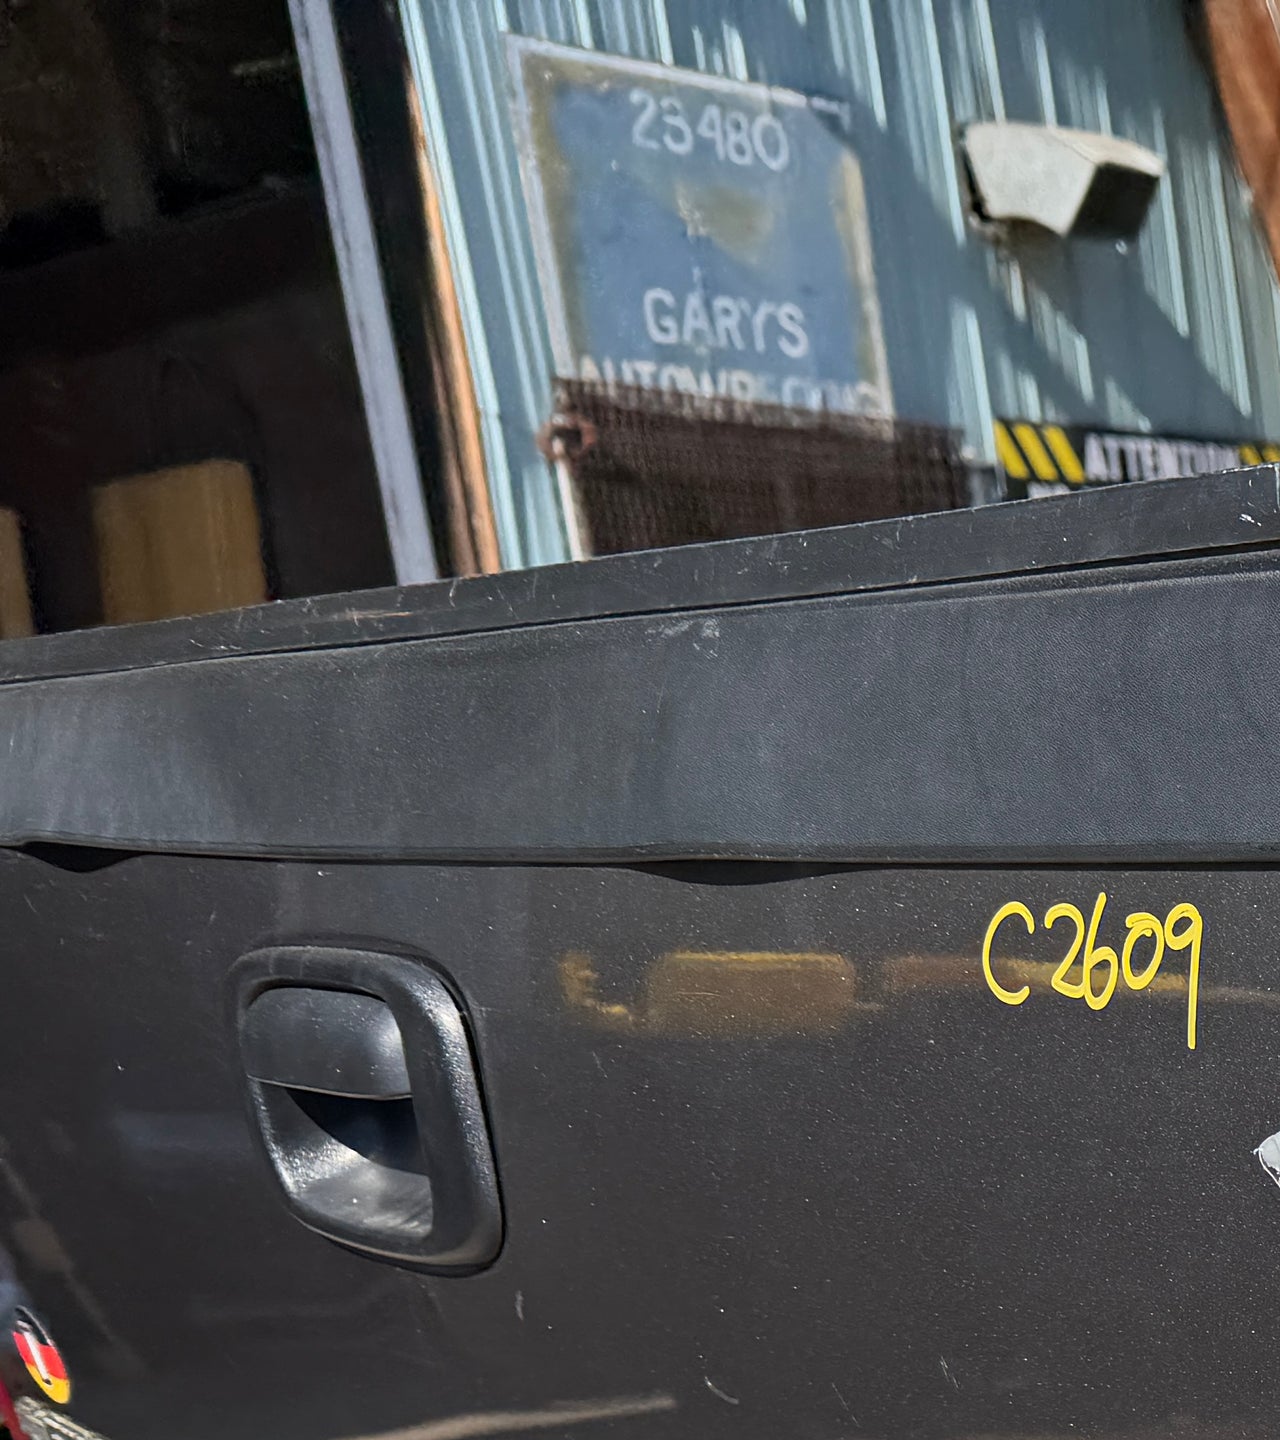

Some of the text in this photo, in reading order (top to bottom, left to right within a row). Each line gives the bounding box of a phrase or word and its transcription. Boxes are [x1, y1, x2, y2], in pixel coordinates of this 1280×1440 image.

[629, 88, 790, 171] 23480
[643, 286, 808, 359] GARYS
[982, 891, 1203, 1050] C2609
